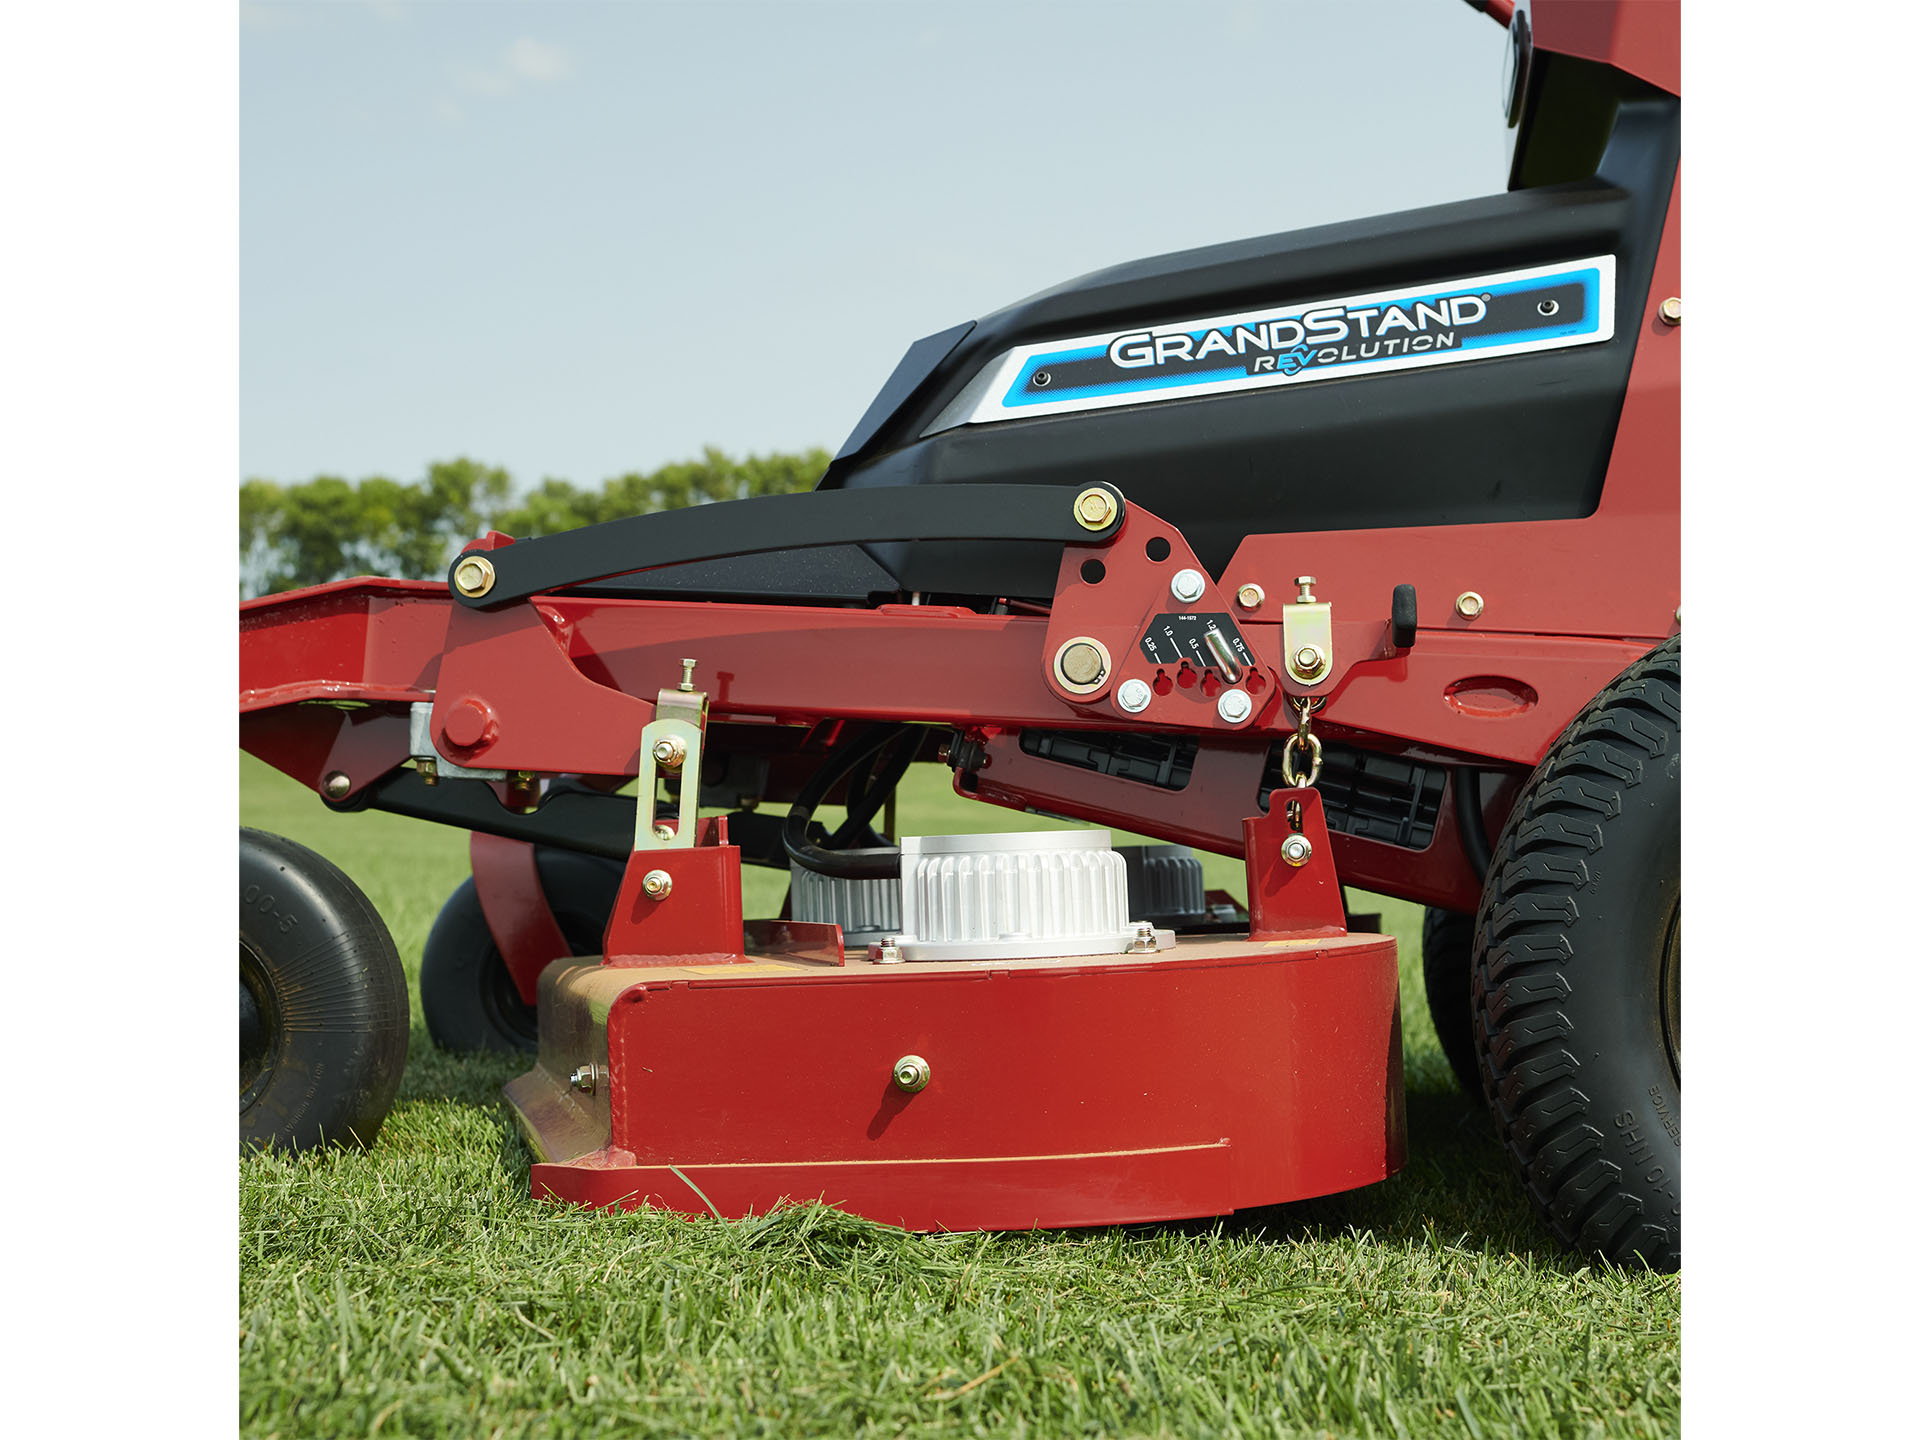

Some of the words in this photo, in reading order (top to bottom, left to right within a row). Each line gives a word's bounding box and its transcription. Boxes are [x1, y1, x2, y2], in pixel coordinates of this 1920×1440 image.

[1254, 332, 1455, 374] REVOLUTION
[1163, 625, 1174, 637] 1.0
[1206, 619, 1217, 630] 1.2
[1144, 637, 1158, 652] 0.25
[1188, 638, 1200, 650] 0.5
[1232, 637, 1245, 653] 0.75
